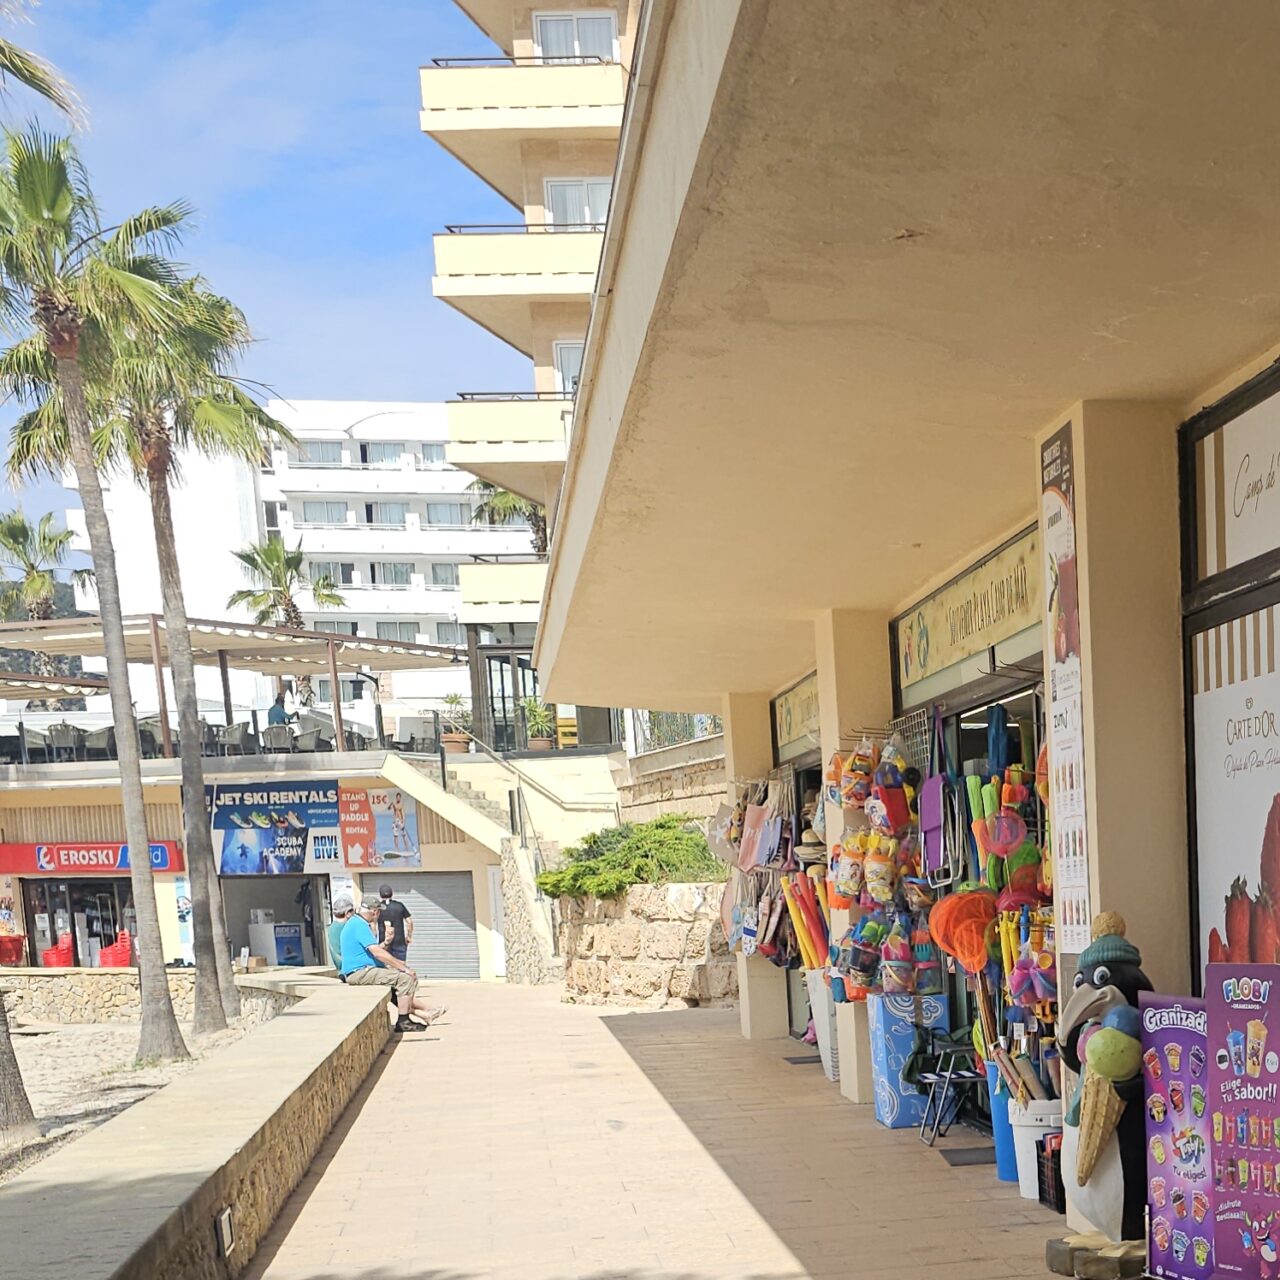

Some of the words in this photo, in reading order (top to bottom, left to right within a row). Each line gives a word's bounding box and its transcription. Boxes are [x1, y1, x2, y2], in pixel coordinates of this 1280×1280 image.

[1234, 453, 1264, 518] Camp
[1265, 453, 1276, 490] de
[1227, 718, 1252, 746] CARTE
[216, 792, 243, 806] JET
[244, 791, 269, 805] SKI
[270, 789, 338, 805] RENTALS
[341, 793, 366, 801] STAND
[371, 794, 388, 805] 15€
[350, 803, 360, 811] UP
[341, 812, 370, 822] PADDLE
[345, 826, 369, 835] RENTAL
[276, 836, 304, 846] SCUBA
[60, 849, 114, 865] EROSKI
[263, 846, 303, 858] ACADEMY
[314, 847, 339, 860] DIVE
[1222, 976, 1270, 1004] FLOBI
[1143, 1005, 1207, 1035] Granizad
[1220, 1078, 1242, 1093] Elige
[1235, 1082, 1278, 1103] sabor!!
[1222, 1093, 1232, 1104] Tu
